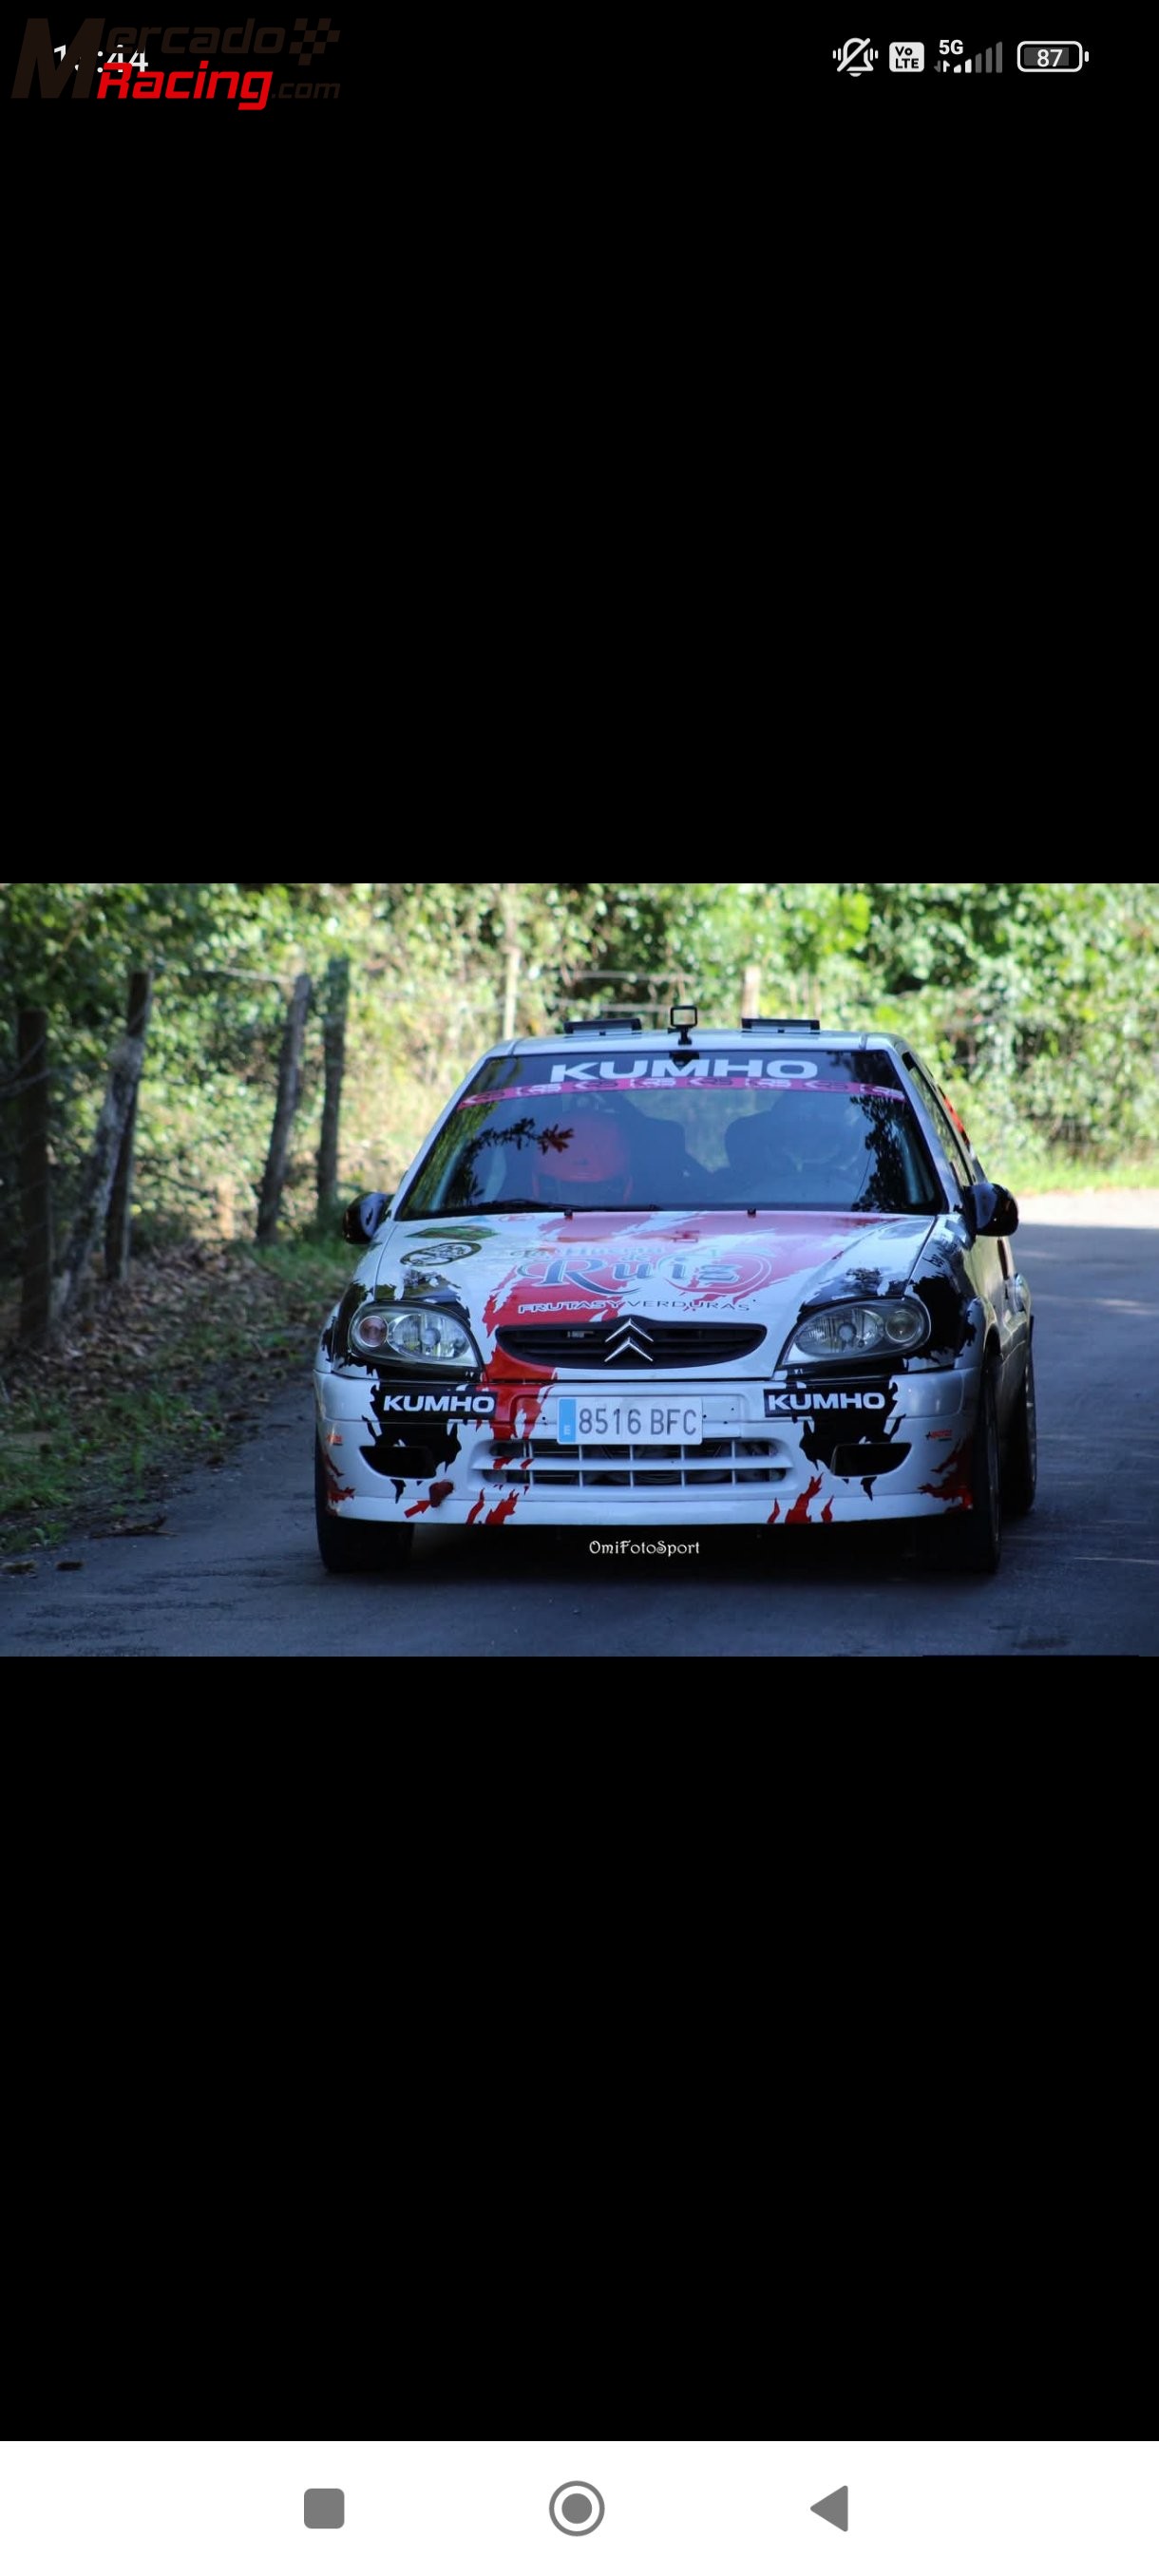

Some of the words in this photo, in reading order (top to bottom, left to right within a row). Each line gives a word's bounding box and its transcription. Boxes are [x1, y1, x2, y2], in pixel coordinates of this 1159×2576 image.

[895, 46, 913, 57] Vo
[939, 39, 964, 55] 5G
[895, 57, 920, 69] LTE
[1037, 48, 1063, 67] 87
[550, 1059, 818, 1083] KUMHO
[517, 1257, 741, 1295] Ruiz
[627, 1300, 750, 1312] VERDURAS
[383, 1395, 496, 1412] KUMHO
[768, 1392, 885, 1411] KUMHO
[579, 1408, 642, 1435] 8516
[650, 1409, 697, 1436] BFC
